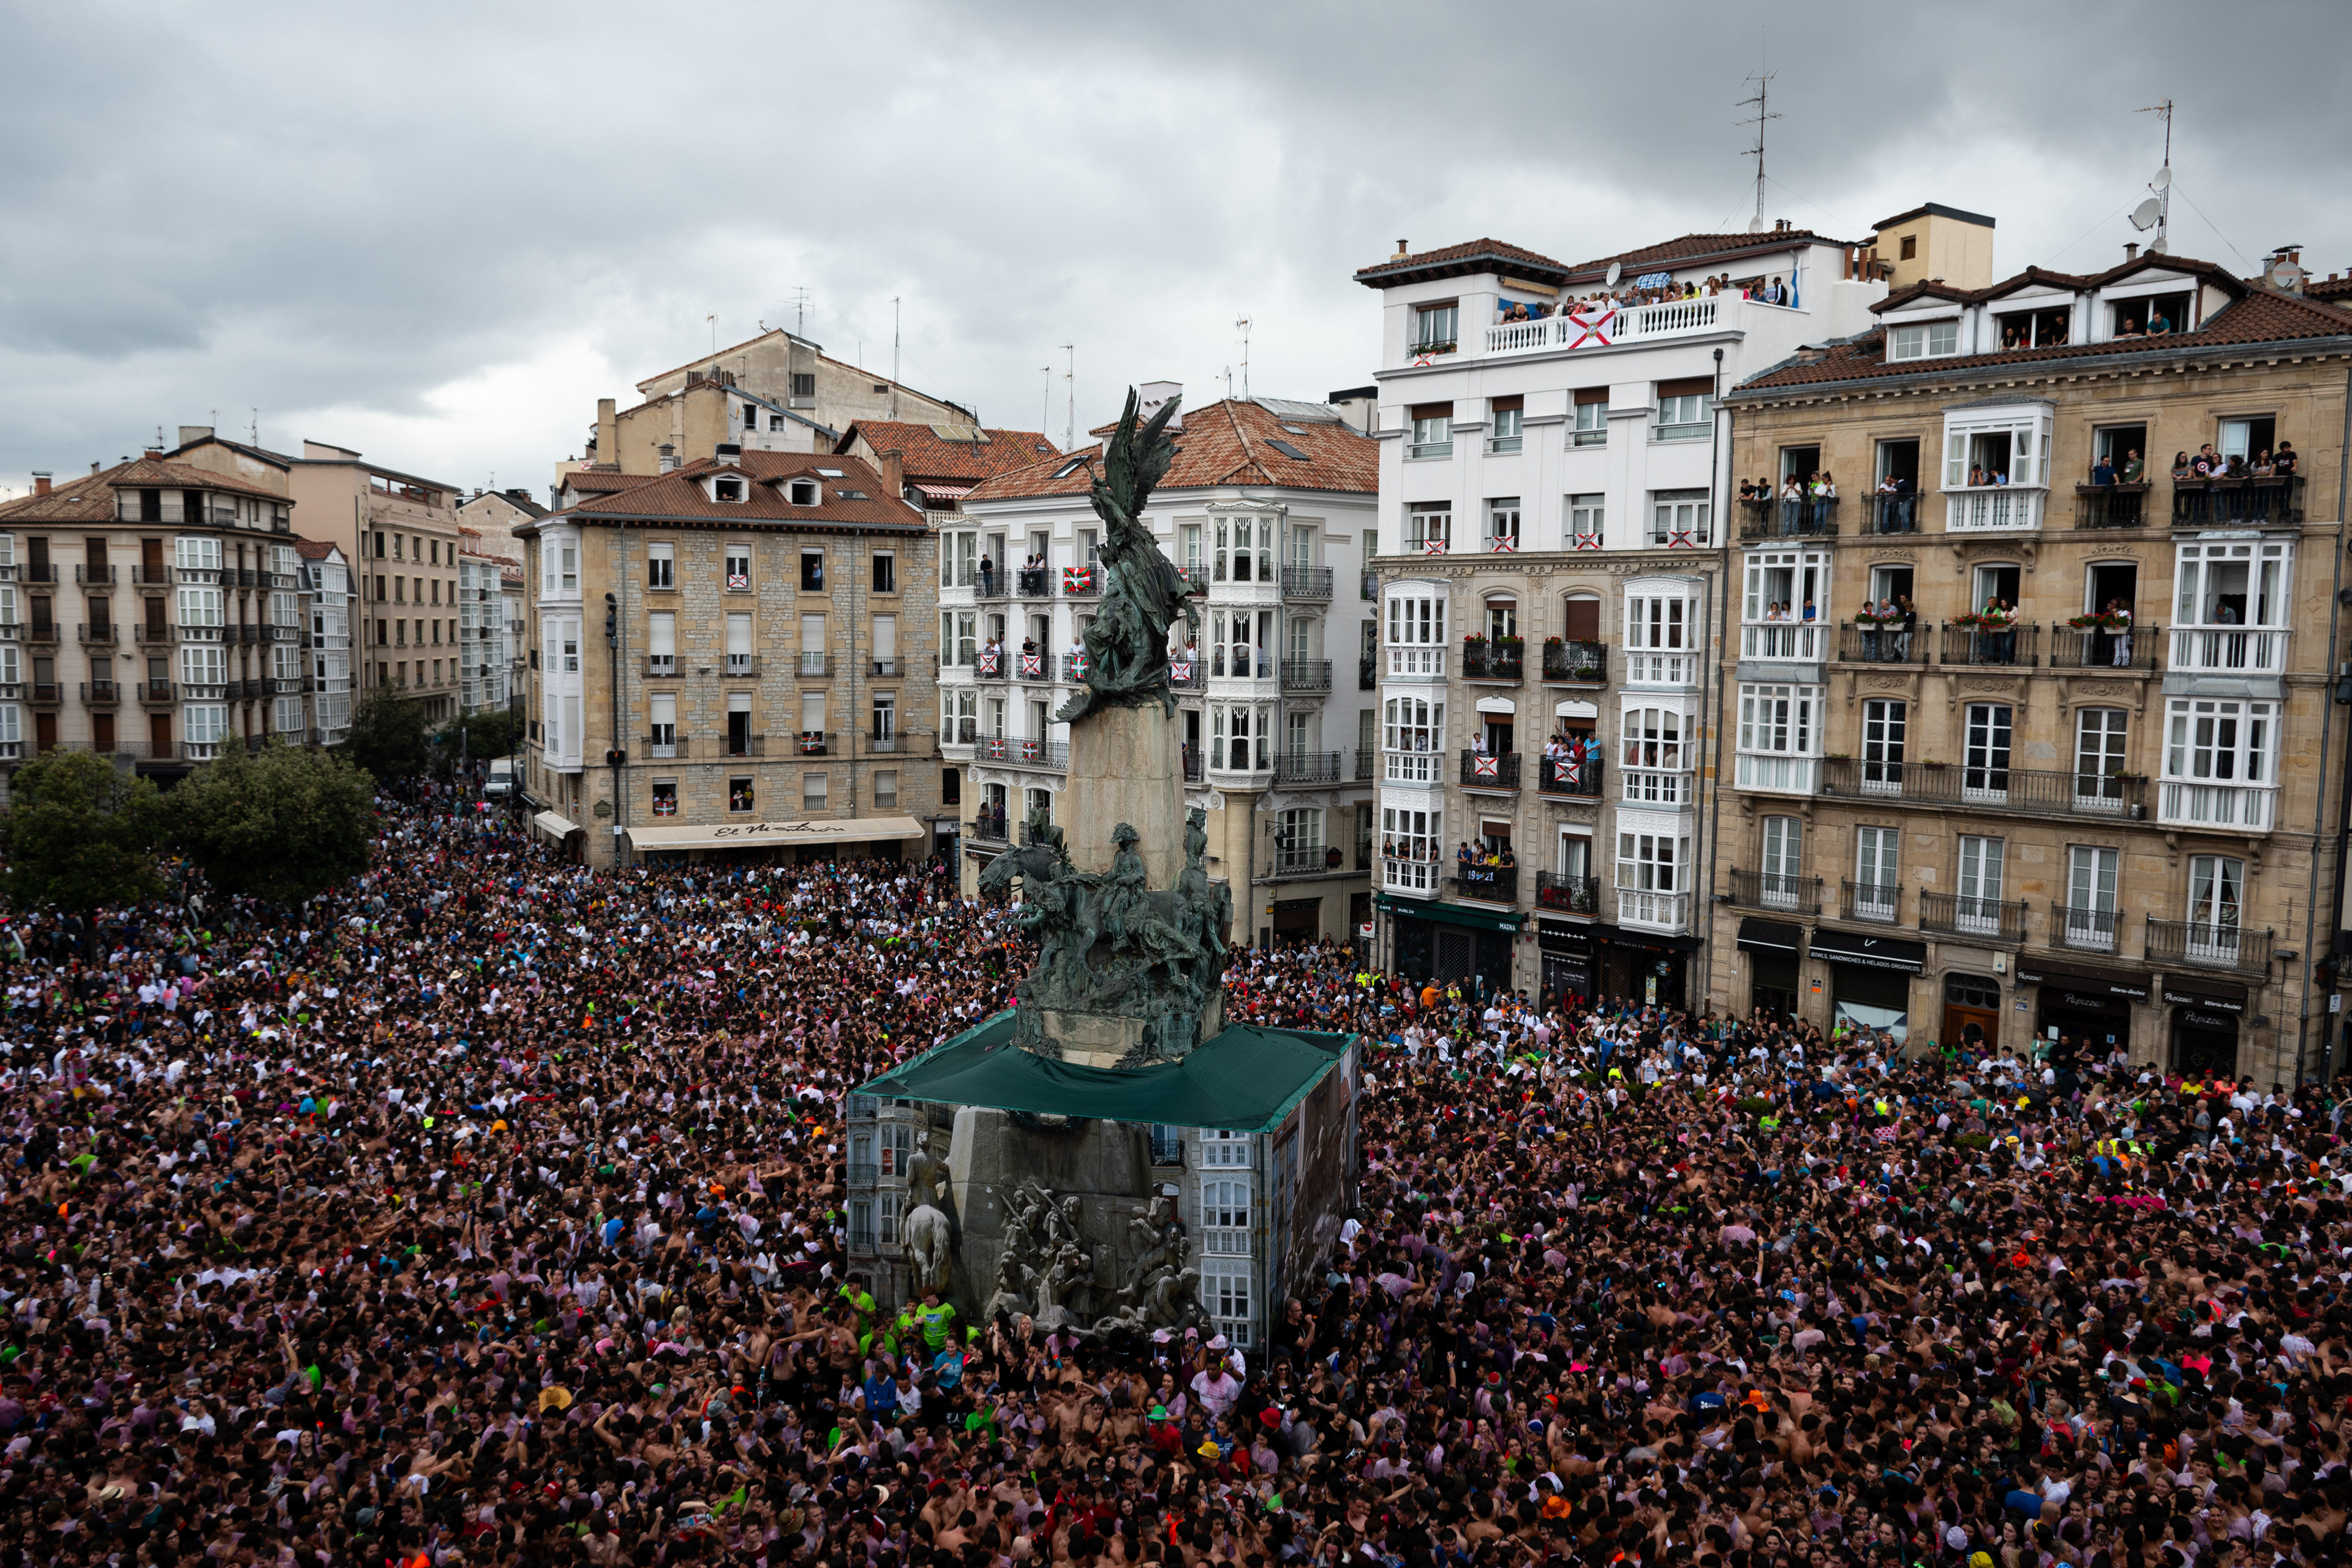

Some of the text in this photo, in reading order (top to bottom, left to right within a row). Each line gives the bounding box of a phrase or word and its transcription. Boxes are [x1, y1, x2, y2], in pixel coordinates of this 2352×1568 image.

[714, 827, 739, 837] El
[1468, 870, 1494, 881] 19 21
[1499, 922, 1516, 931] MAGNA
[1542, 930, 1585, 940] IKURRAK
[1829, 954, 1861, 963] SANDWICHES
[1891, 962, 1920, 971] ORGÁNICOS
[2017, 972, 2040, 981] Papizza
[2111, 987, 2146, 996] Vitoria-Gasteiz
[2065, 993, 2100, 1007] Papizza
[2165, 993, 2190, 1003] Papizza
[2204, 1000, 2242, 1010] Vitoria-Gasteiz
[2184, 1011, 2223, 1025] Papizza
